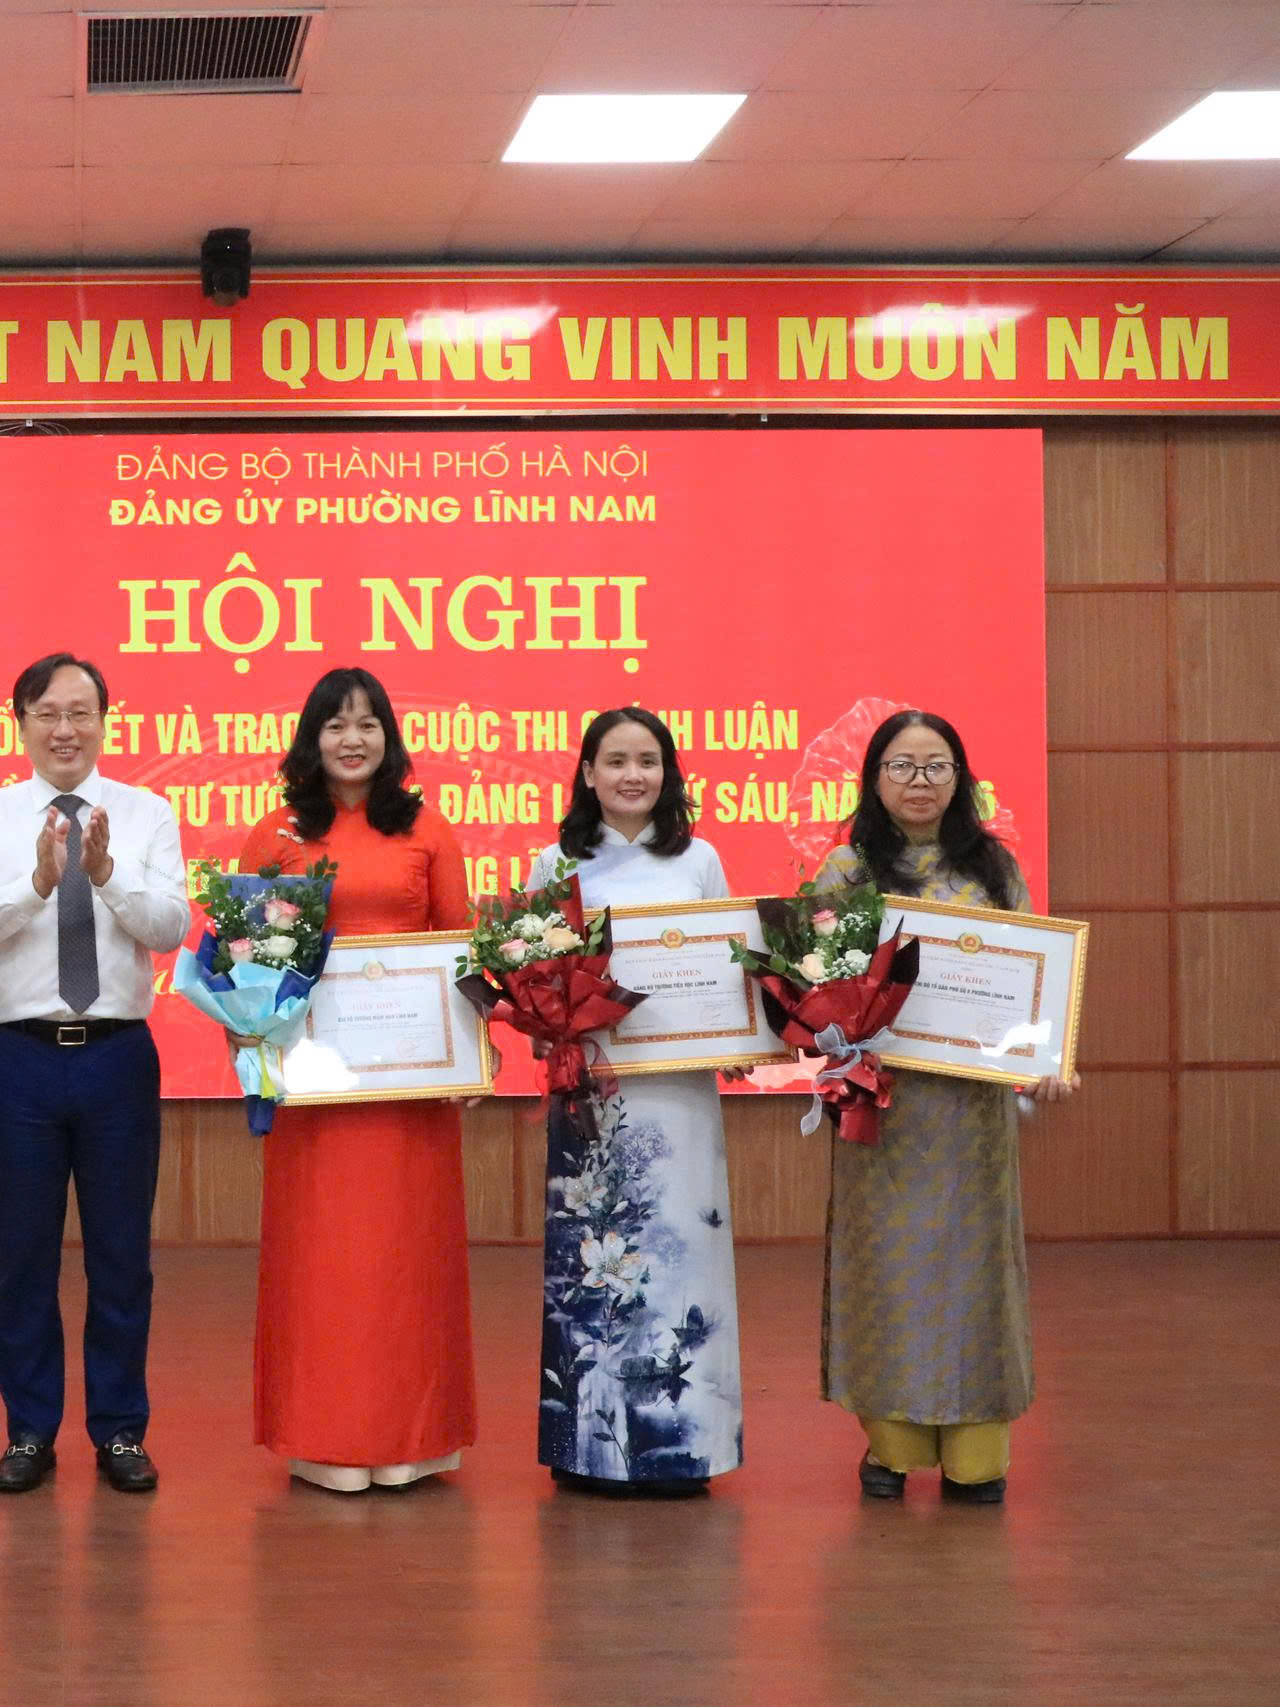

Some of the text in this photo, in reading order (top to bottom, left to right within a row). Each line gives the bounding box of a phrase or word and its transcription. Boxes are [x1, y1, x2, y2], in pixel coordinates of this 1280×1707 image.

[47, 319, 232, 383] NAM
[262, 317, 532, 389] QUANG
[559, 316, 748, 381] VINH
[778, 305, 1017, 382] MUÔN
[1047, 303, 1229, 381] NĂM
[116, 443, 648, 484] ĐẢNG BỘ THÀNH PHỐ HÀ NỘI
[109, 488, 656, 526] ĐẢNG ỦY PHƯỜNG LĨNH NAM
[119, 552, 648, 673] HỘI NGHỊ
[103, 700, 145, 755] ẾT
[155, 704, 202, 755] VÀ
[402, 703, 501, 761] CUỘC
[512, 711, 569, 752] THI
[704, 700, 798, 760] LUẬN
[166, 781, 216, 827] TƯ
[439, 769, 540, 825] ĐẢNG
[715, 772, 800, 828] SÁU,
[811, 772, 861, 823] NĂ
